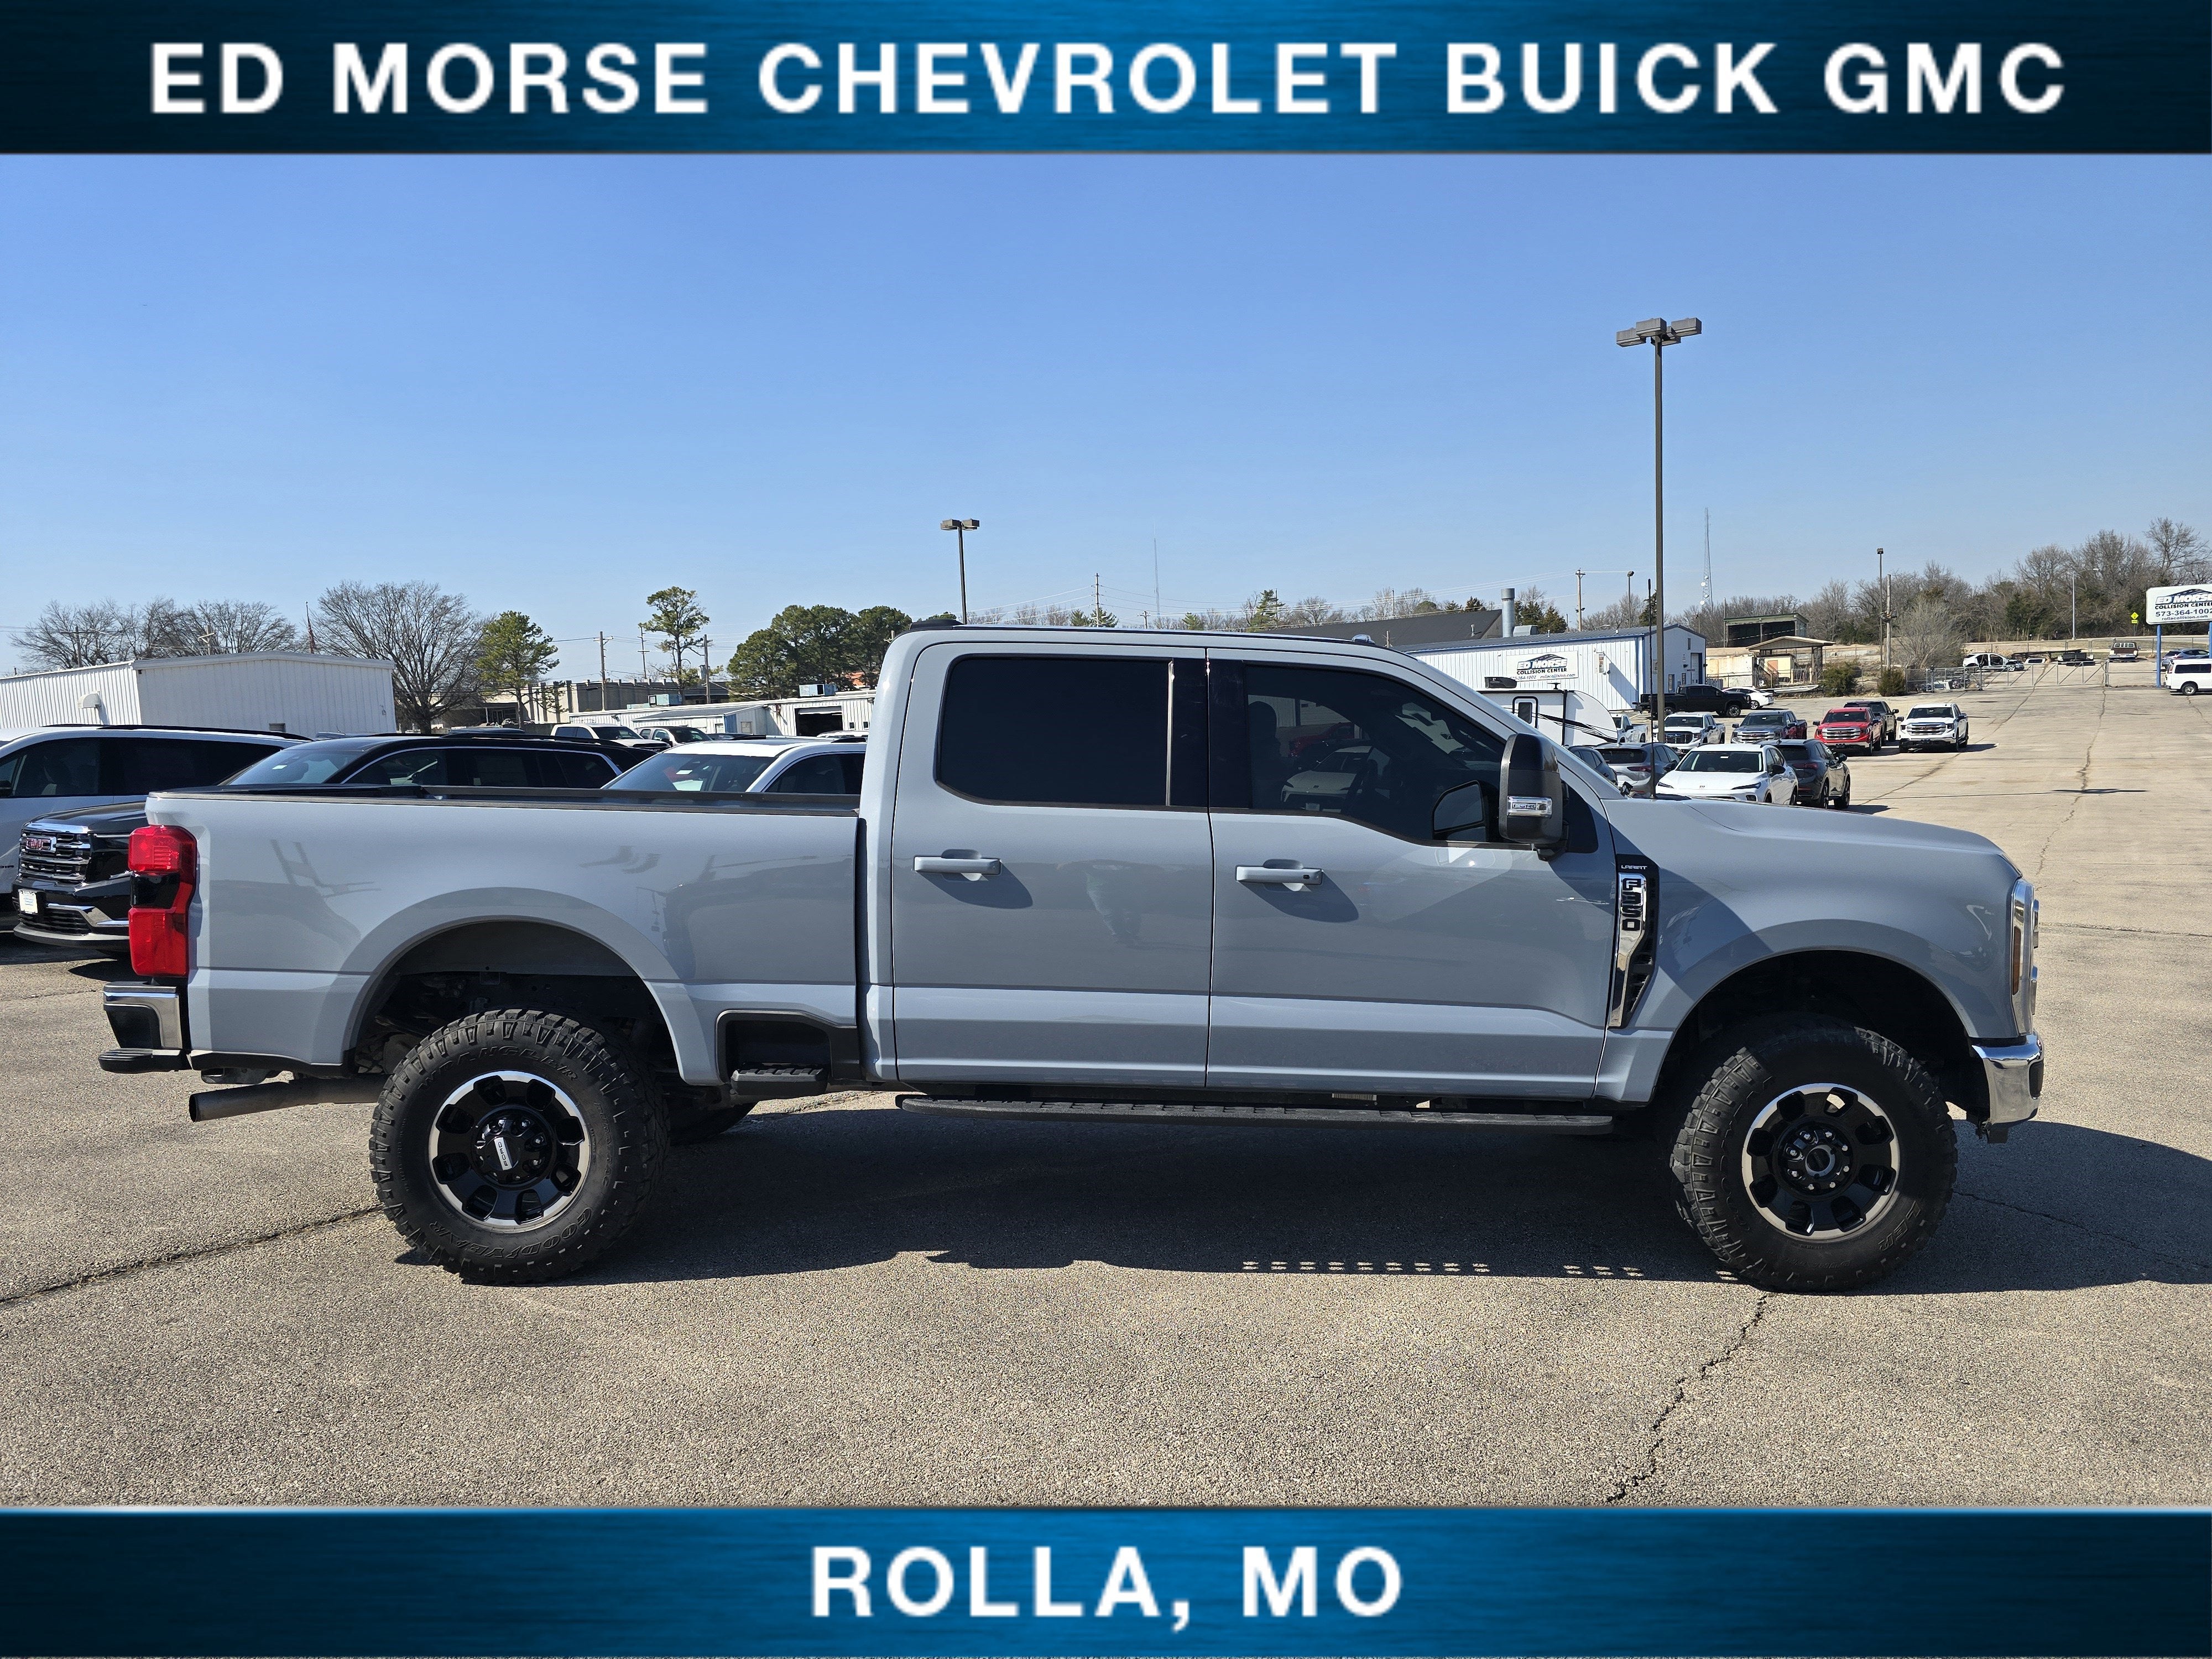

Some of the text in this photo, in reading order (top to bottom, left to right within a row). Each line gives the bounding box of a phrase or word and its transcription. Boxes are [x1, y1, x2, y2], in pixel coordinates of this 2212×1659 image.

[2156, 596, 2173, 605] ED
[2155, 608, 2212, 617] 573-364-1002
[1517, 659, 1567, 670] ED MORSE
[26, 837, 51, 851] GMC
[418, 1045, 579, 1091] WRANGLER
[498, 1141, 509, 1166] FORD
[429, 1207, 593, 1259] GOODYEAR
